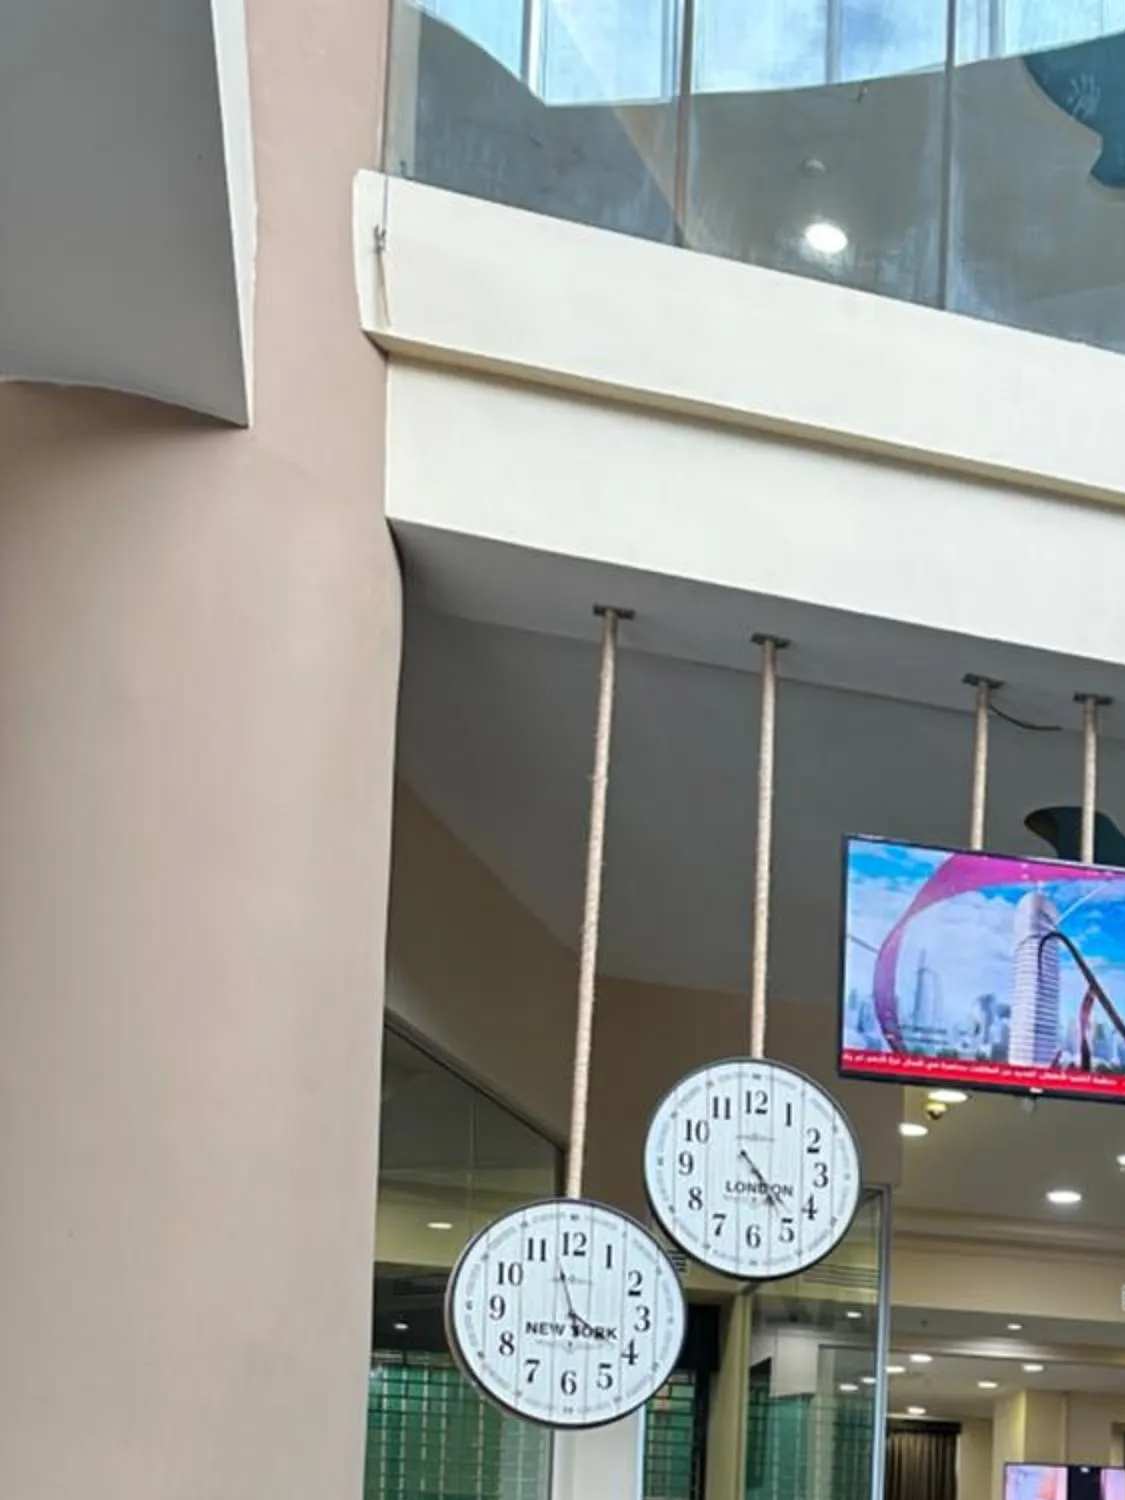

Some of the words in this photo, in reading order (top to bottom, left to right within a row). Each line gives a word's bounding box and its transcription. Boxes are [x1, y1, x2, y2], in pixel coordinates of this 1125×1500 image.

[712, 1096, 731, 1120] 11
[745, 1090, 768, 1114] 12
[785, 1103, 792, 1126] 1
[685, 1120, 709, 1143] 10
[807, 1128, 821, 1153] 2
[679, 1152, 694, 1175] 9
[814, 1163, 828, 1187] 3
[688, 1187, 703, 1211] 8
[725, 1180, 794, 1197] LONDON
[801, 1196, 817, 1220] 4
[712, 1214, 726, 1236] 7
[746, 1225, 760, 1248] 6
[779, 1218, 794, 1242] 5
[527, 1238, 547, 1262] 11
[562, 1232, 587, 1257] 12
[605, 1244, 612, 1269] 1
[497, 1262, 523, 1286] 10
[628, 1270, 643, 1296] 2
[490, 1296, 505, 1320] 9
[635, 1307, 650, 1332] 3
[526, 1322, 564, 1336] NEW
[499, 1332, 514, 1356] 8
[621, 1341, 638, 1365] 4
[525, 1359, 540, 1383] 7
[561, 1371, 577, 1395] 6
[597, 1364, 613, 1389] 5
